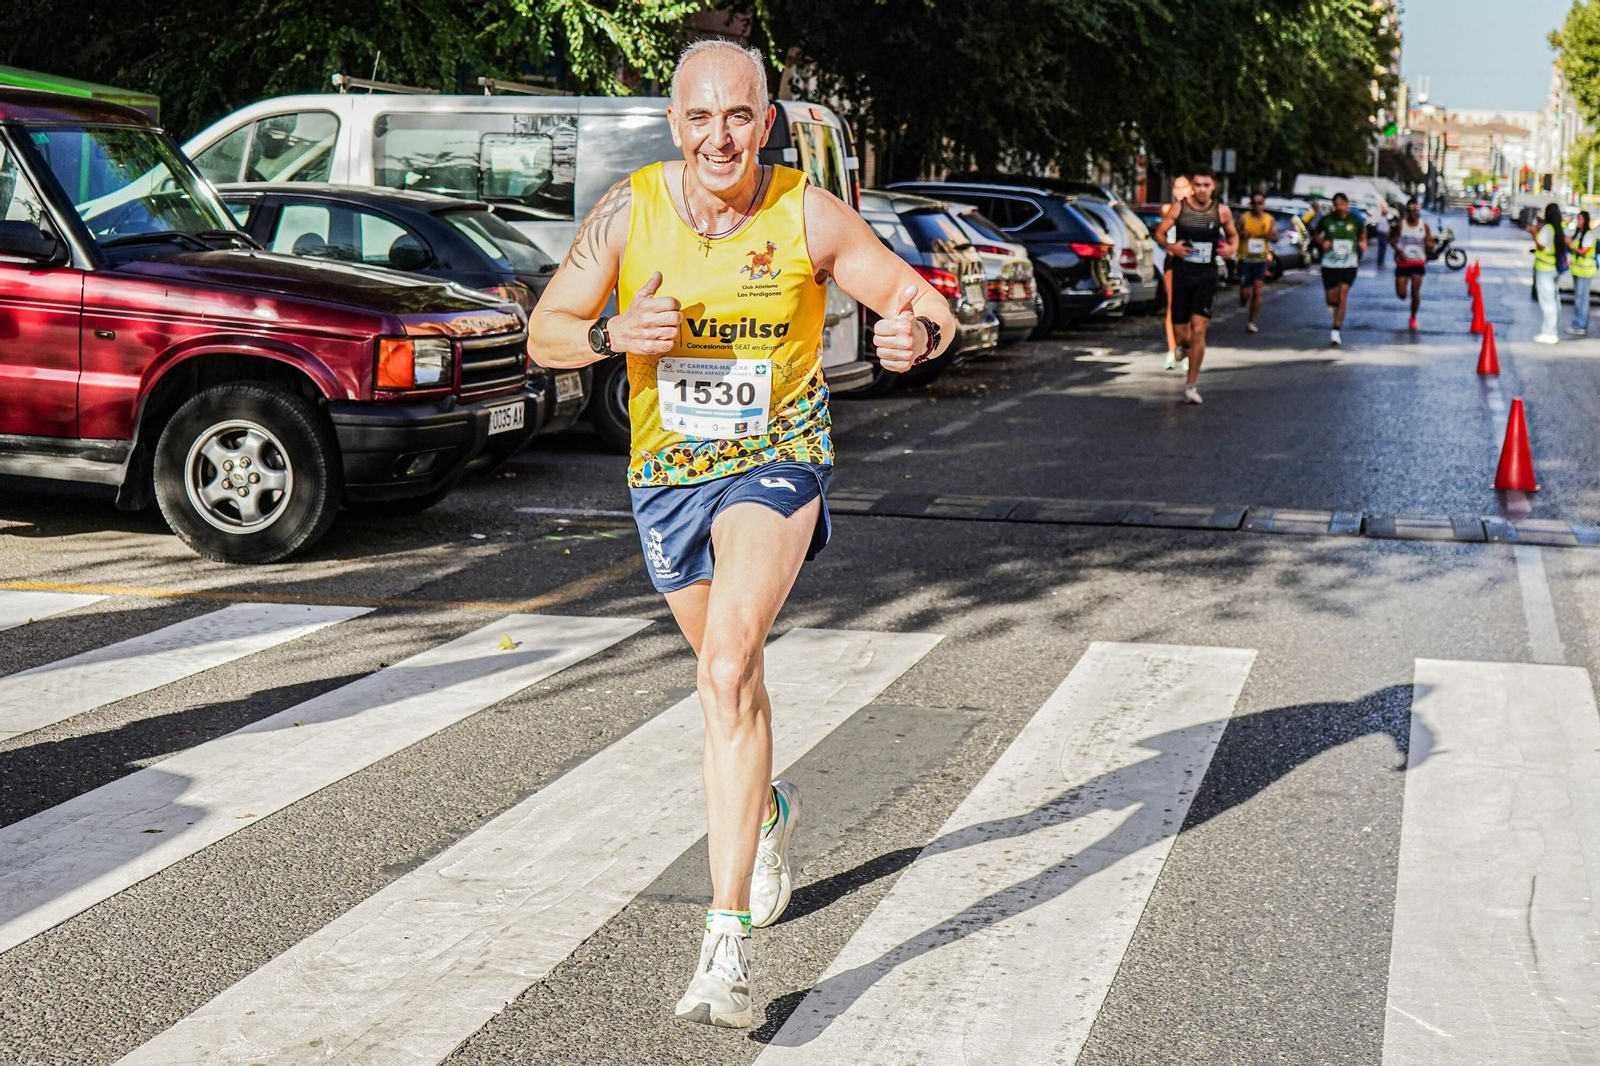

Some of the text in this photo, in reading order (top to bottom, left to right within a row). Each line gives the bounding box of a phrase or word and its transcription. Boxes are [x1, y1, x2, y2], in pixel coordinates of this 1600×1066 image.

[686, 317, 790, 344] Vigilsa
[686, 342, 733, 350] Concesionario
[674, 379, 756, 406] 1530
[492, 405, 524, 430] 0035 AX
